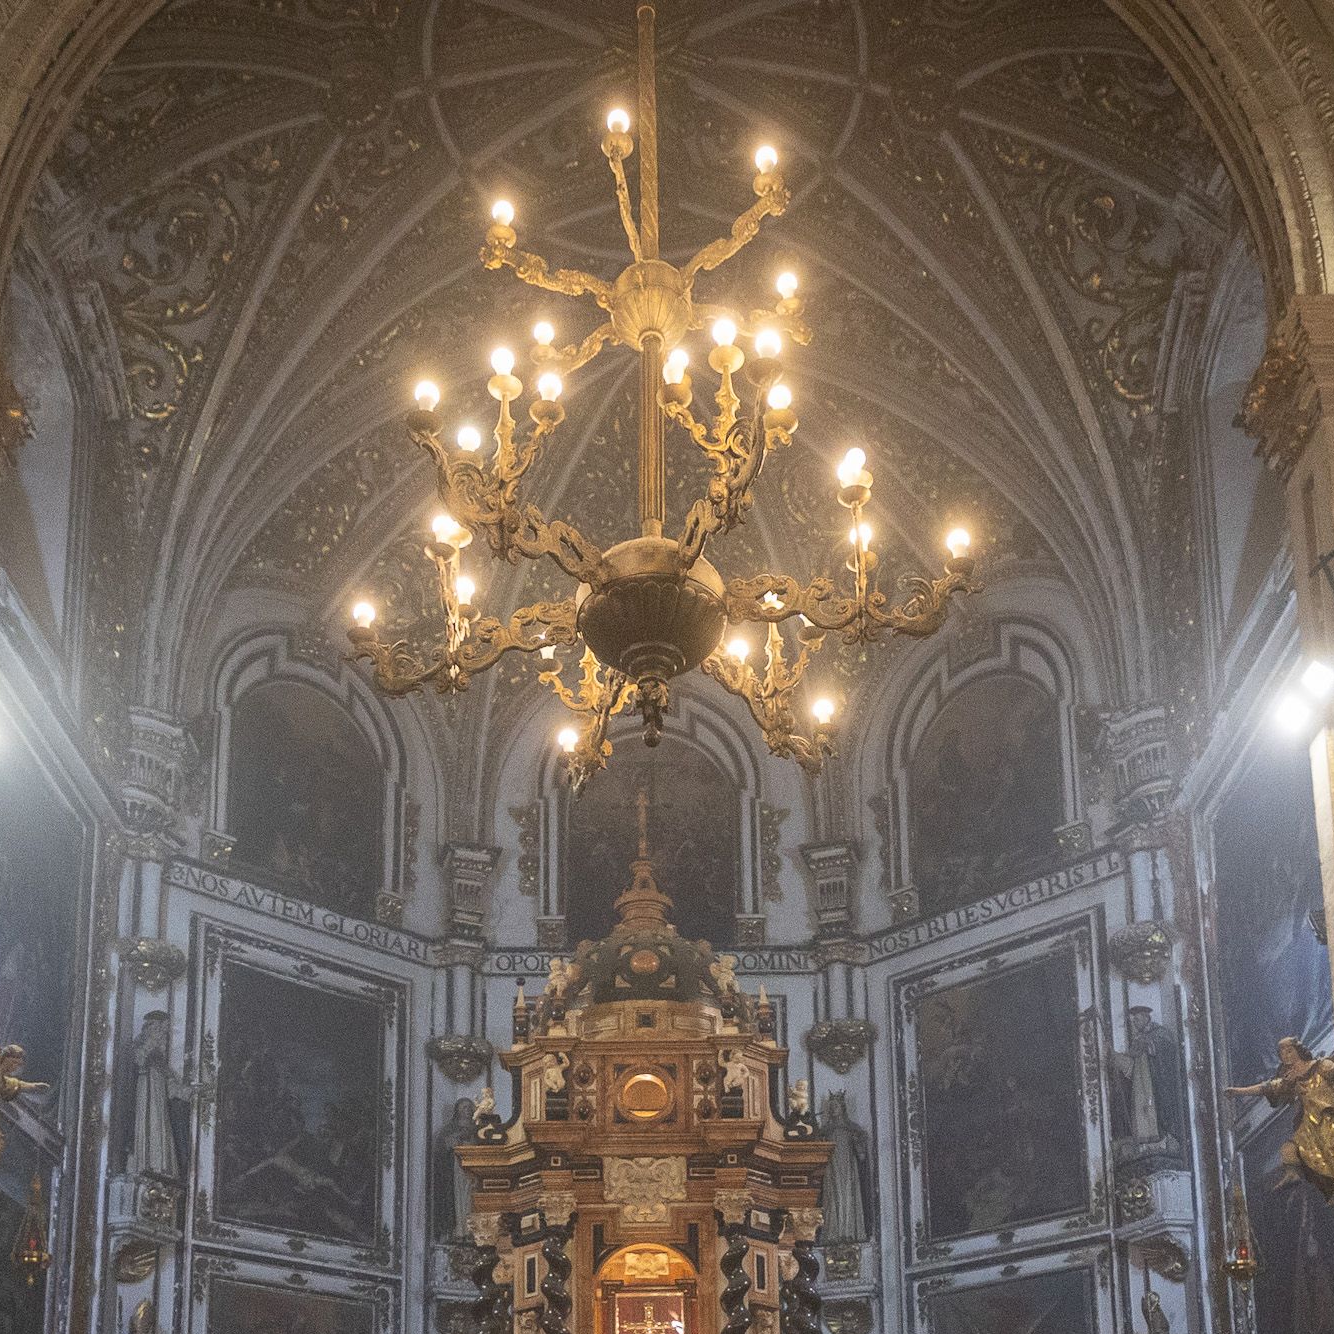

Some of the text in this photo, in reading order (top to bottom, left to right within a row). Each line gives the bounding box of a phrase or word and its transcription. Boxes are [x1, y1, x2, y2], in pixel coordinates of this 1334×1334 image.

[183, 867, 431, 962] NOS AVTEM GLORIARI
[495, 953, 570, 971] OPORT
